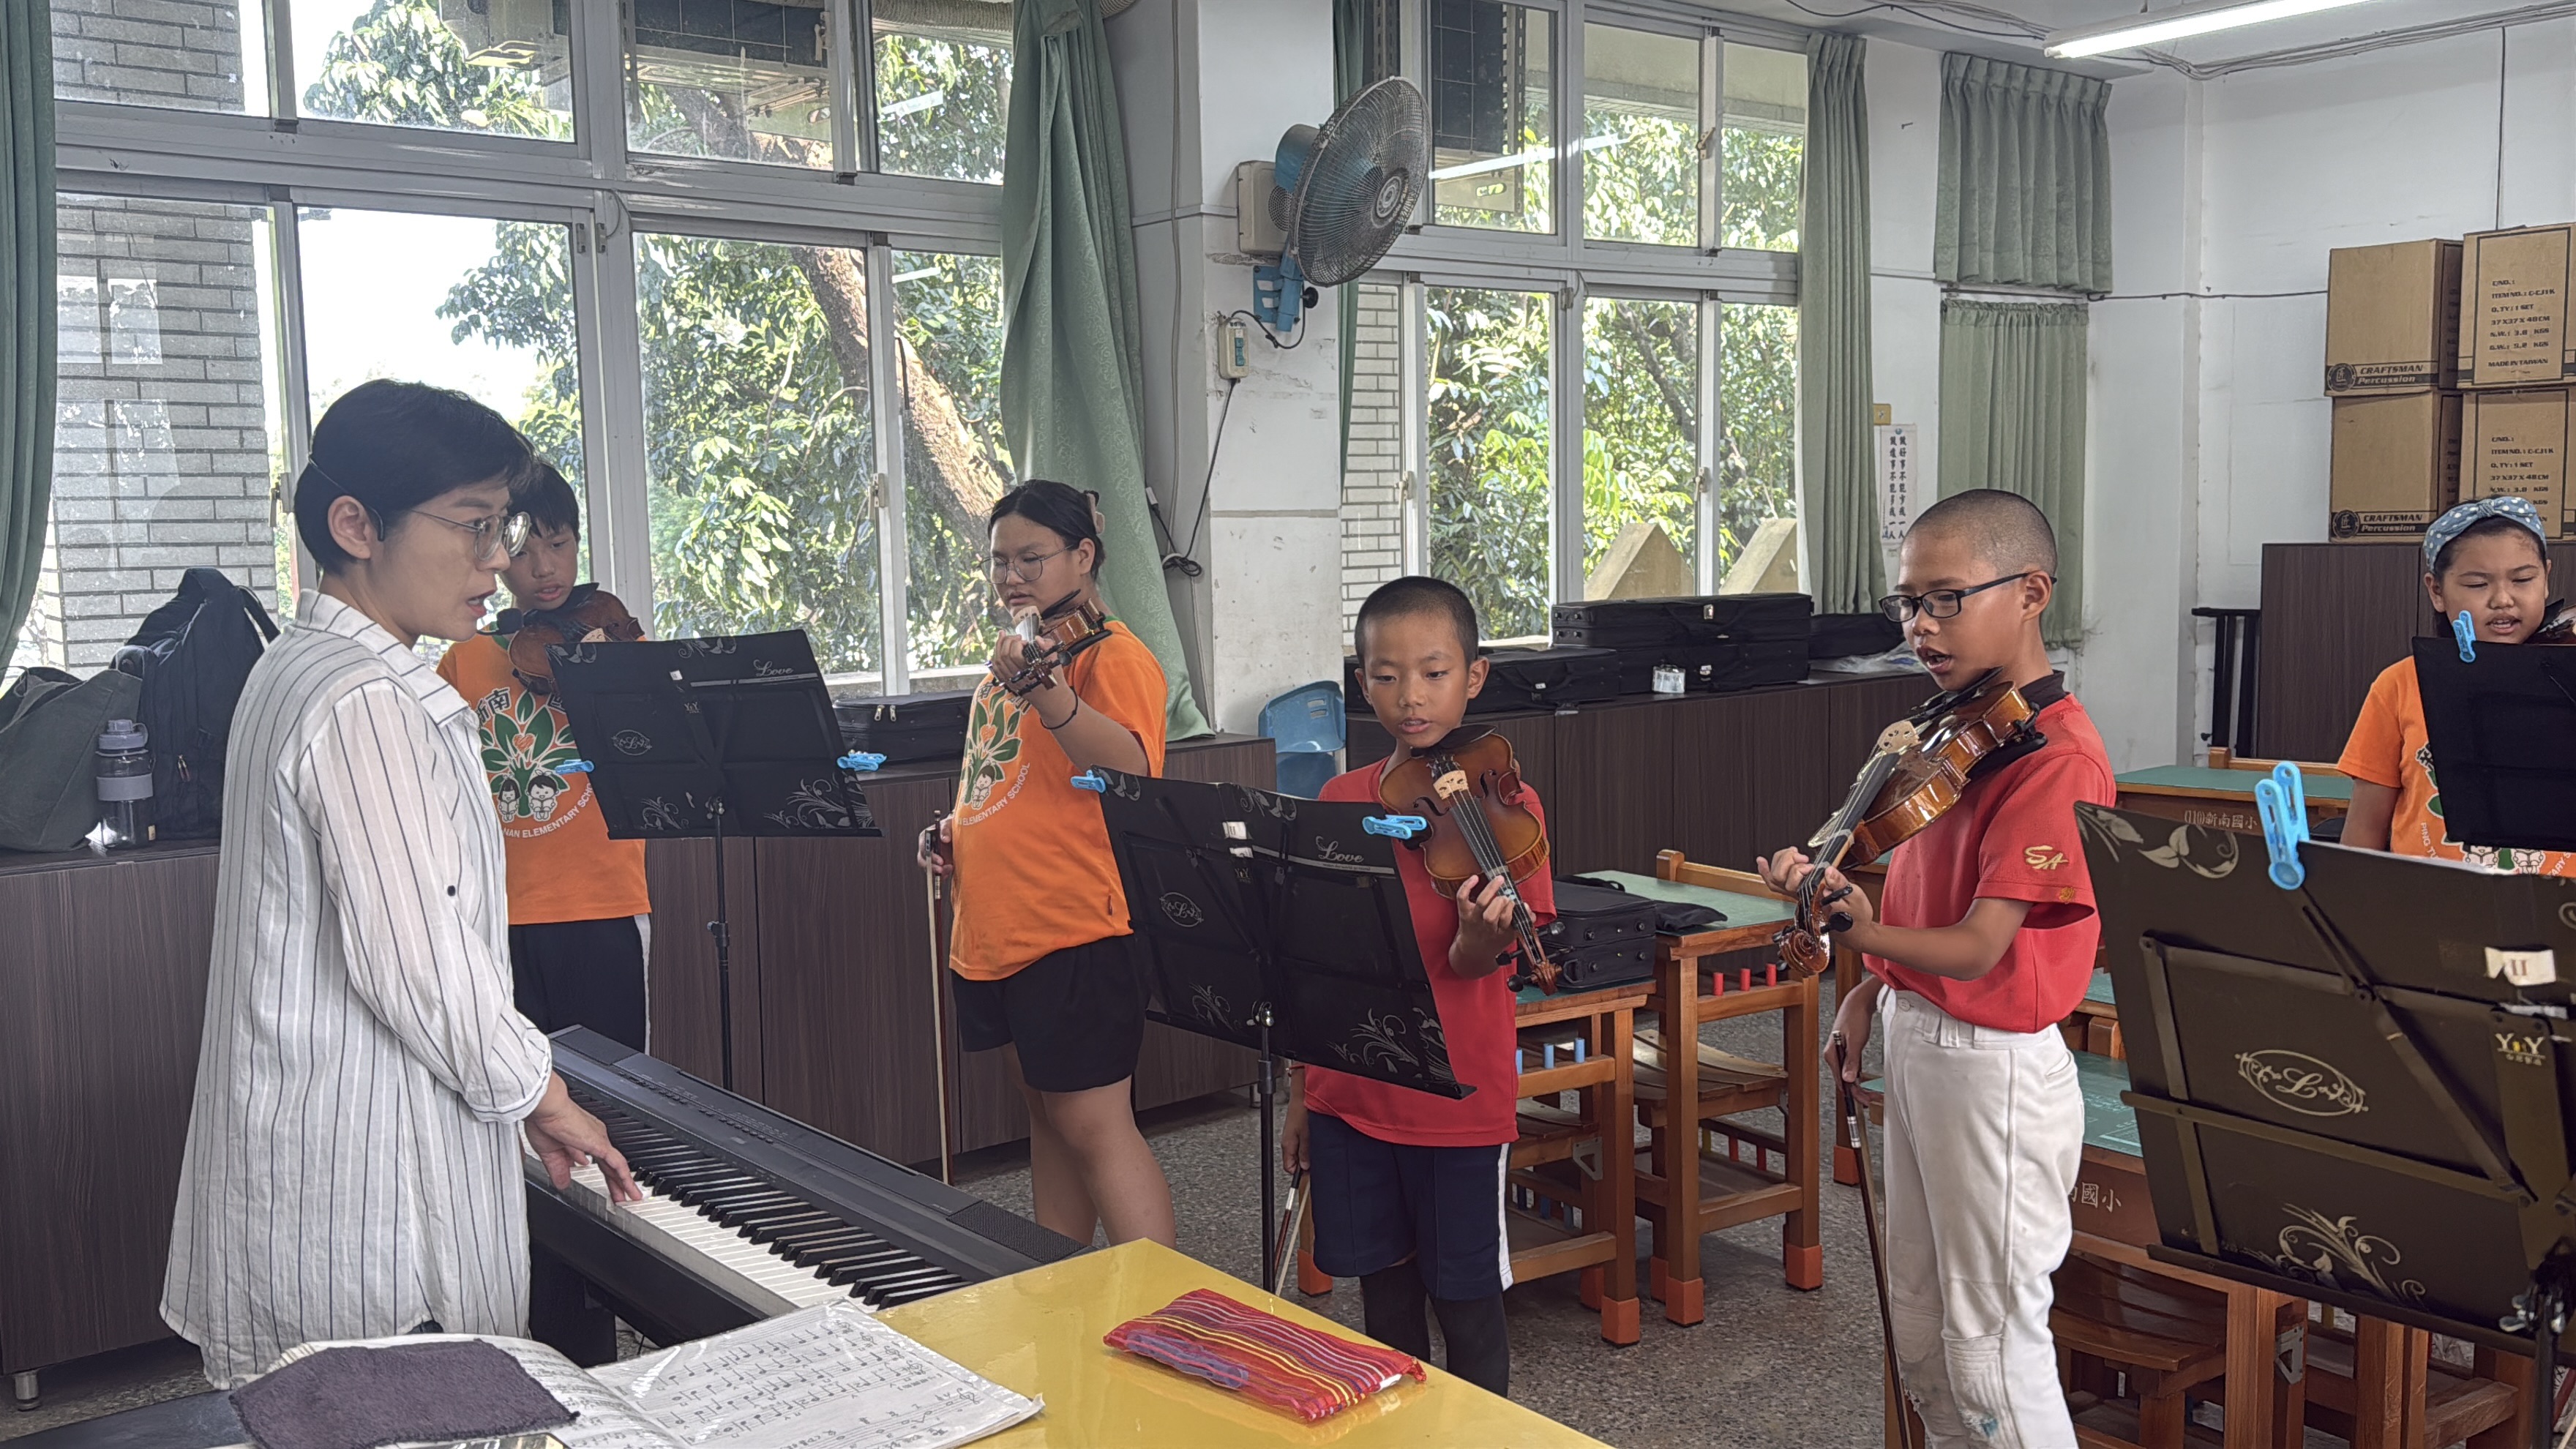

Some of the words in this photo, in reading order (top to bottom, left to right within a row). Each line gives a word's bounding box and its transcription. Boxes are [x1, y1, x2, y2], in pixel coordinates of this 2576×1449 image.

[2357, 375, 2416, 385] Percussion
[2360, 364, 2424, 375] CRAFTSMAN
[2363, 514, 2423, 523] CRAFTSMAN
[754, 659, 794, 677] Love
[962, 795, 1008, 825] ELEMENTARY
[1007, 763, 1030, 799] SCHOOL
[503, 827, 520, 838] NAN
[522, 805, 580, 839] ELEMENTARY
[2420, 822, 2431, 847] PING
[1315, 836, 1365, 863] Love
[2068, 1181, 2122, 1213] 國小
